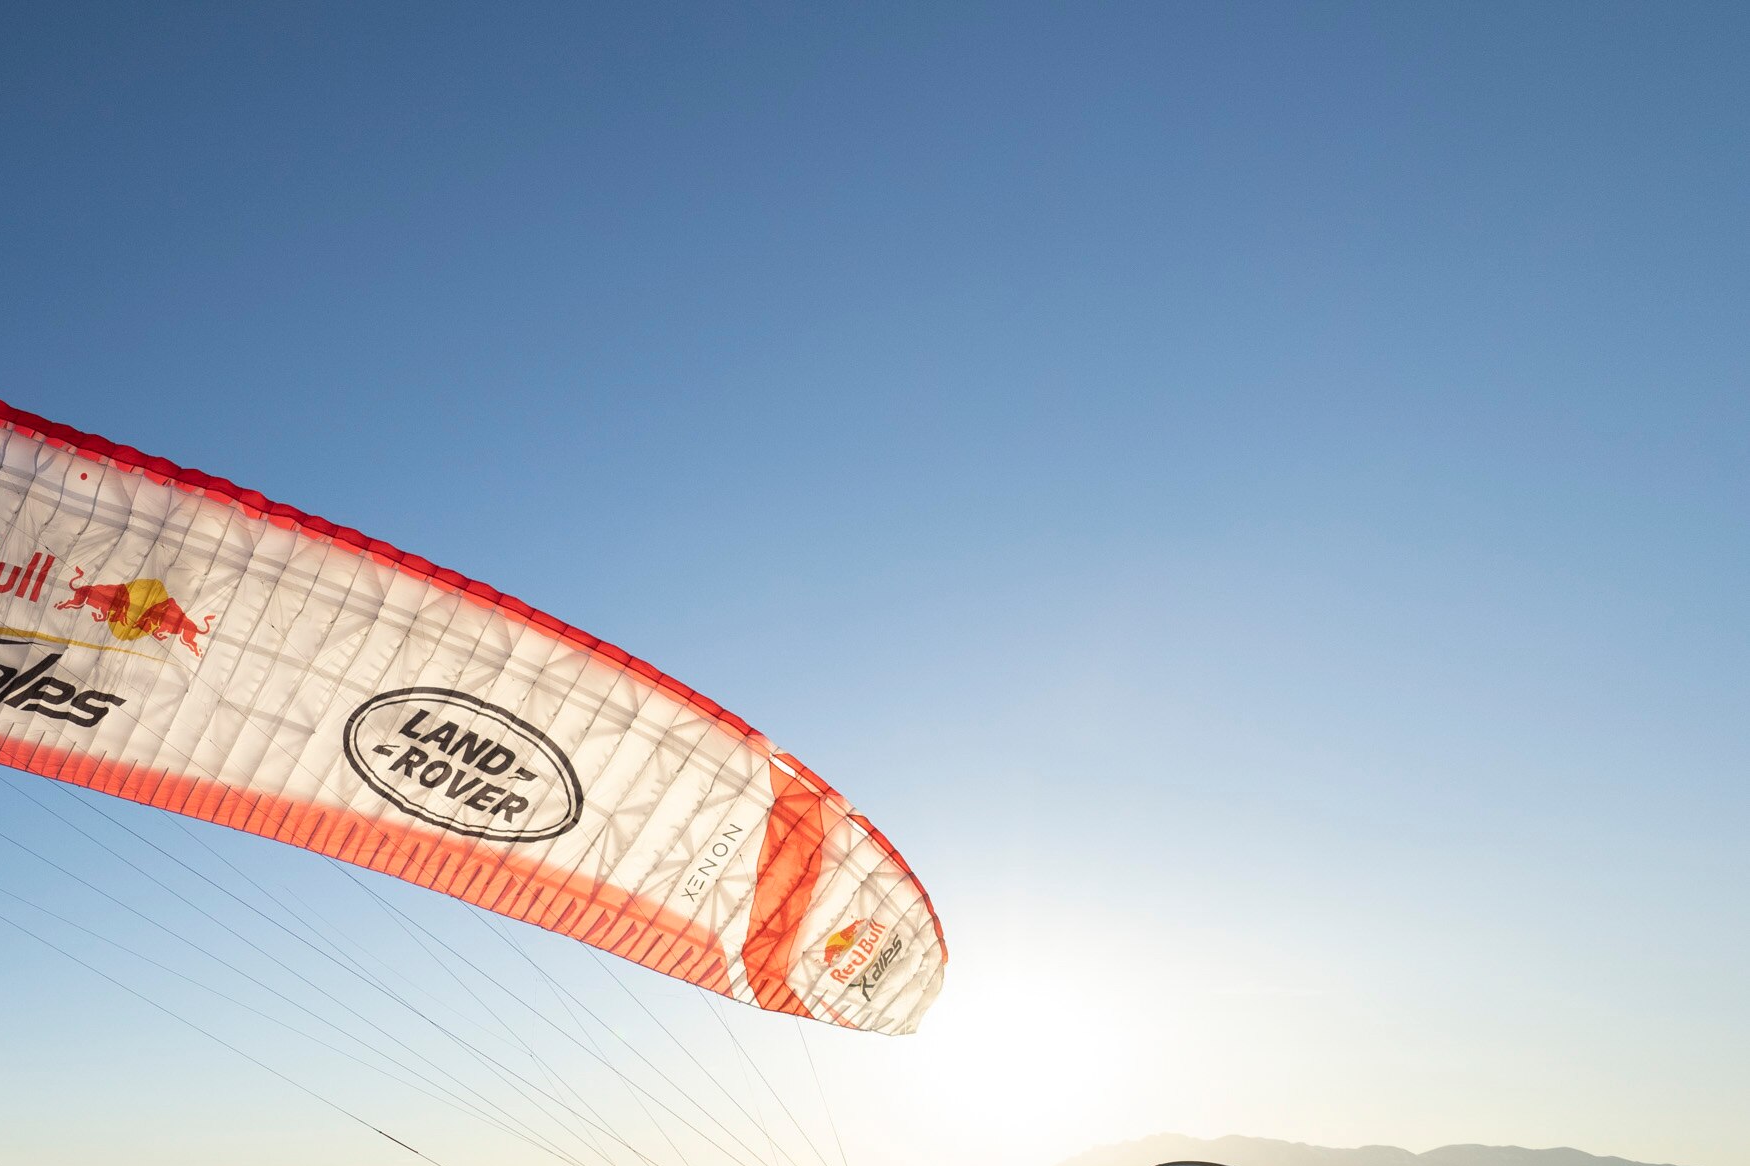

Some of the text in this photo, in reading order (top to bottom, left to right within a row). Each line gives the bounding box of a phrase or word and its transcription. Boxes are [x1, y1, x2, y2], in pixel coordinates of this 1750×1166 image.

[397, 708, 517, 776] LAND
[387, 744, 530, 824] ROVER
[681, 823, 743, 903] XENON
[830, 917, 886, 985] Red Bull
